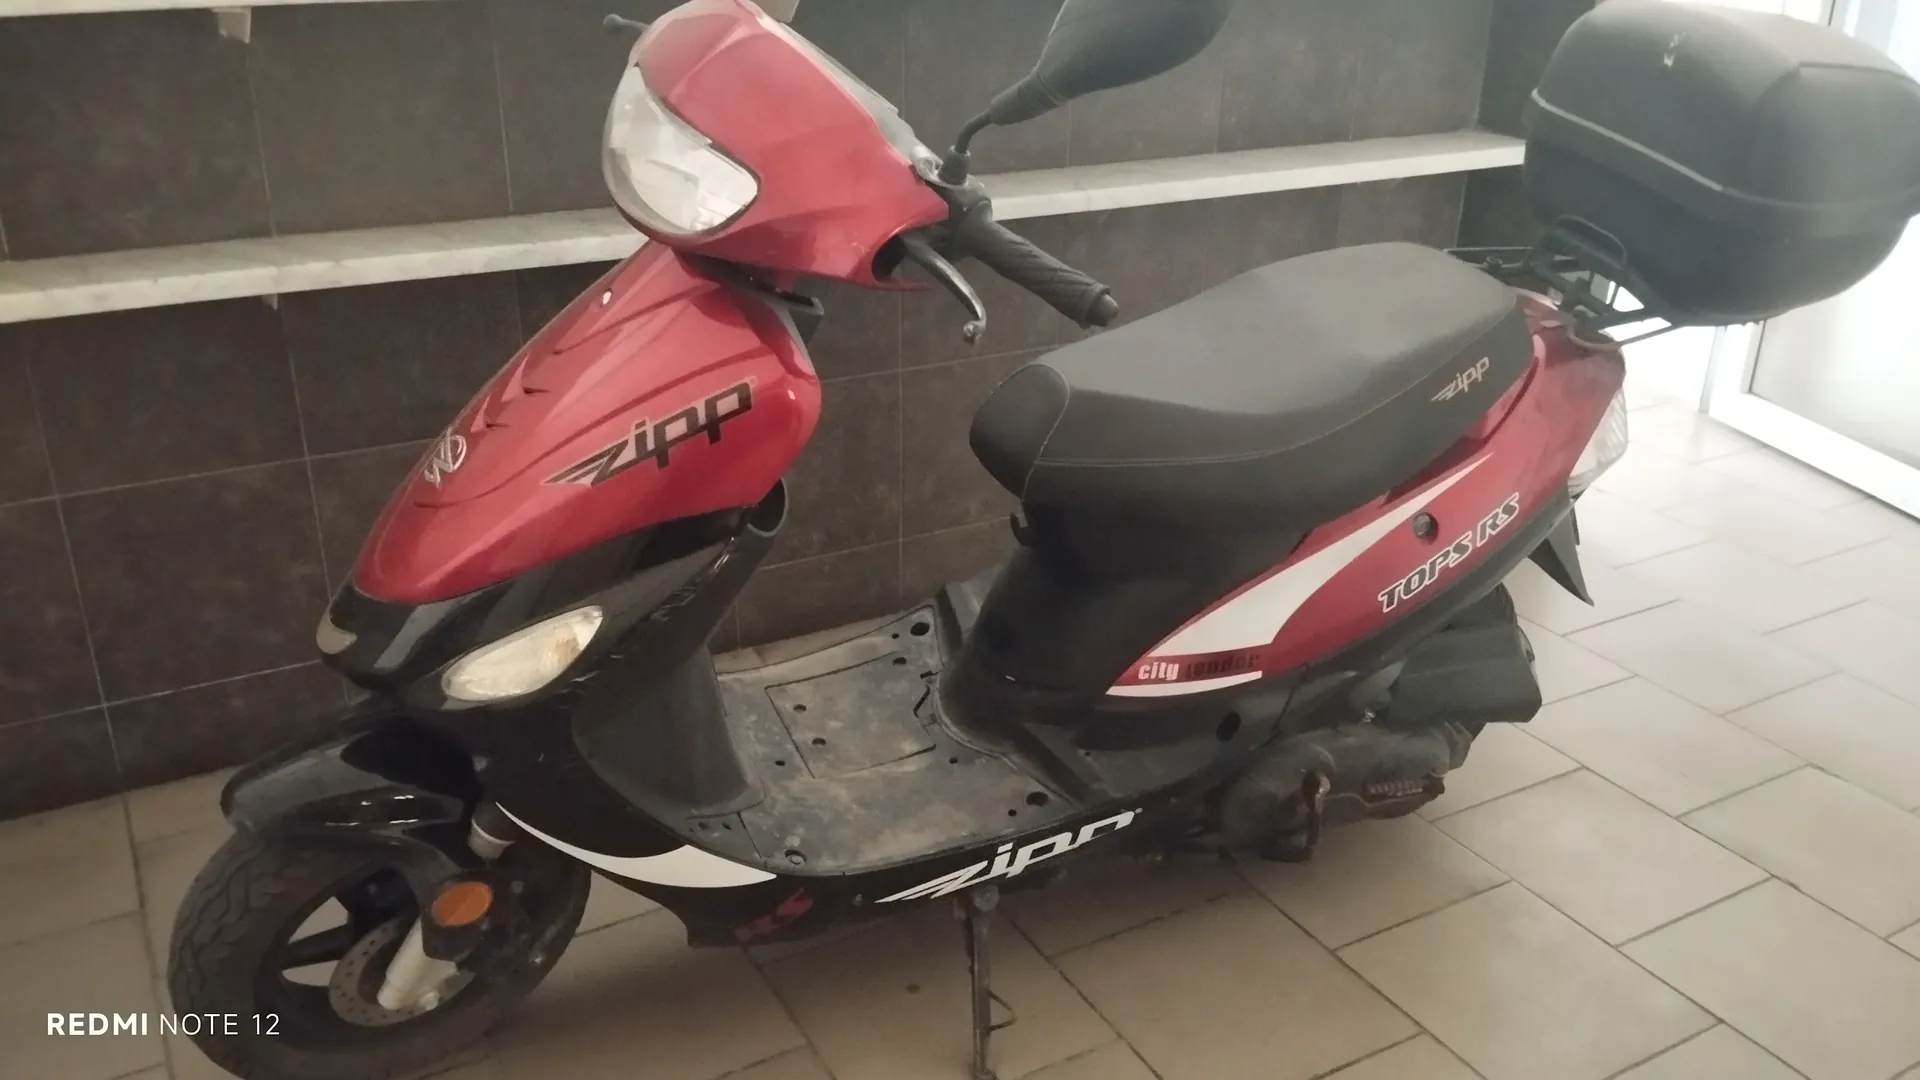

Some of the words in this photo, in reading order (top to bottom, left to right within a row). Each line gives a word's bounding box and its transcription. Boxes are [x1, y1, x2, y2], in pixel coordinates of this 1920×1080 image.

[1377, 531, 1473, 613] TOPS
[1476, 491, 1520, 547] RS
[1138, 661, 1180, 681] city
